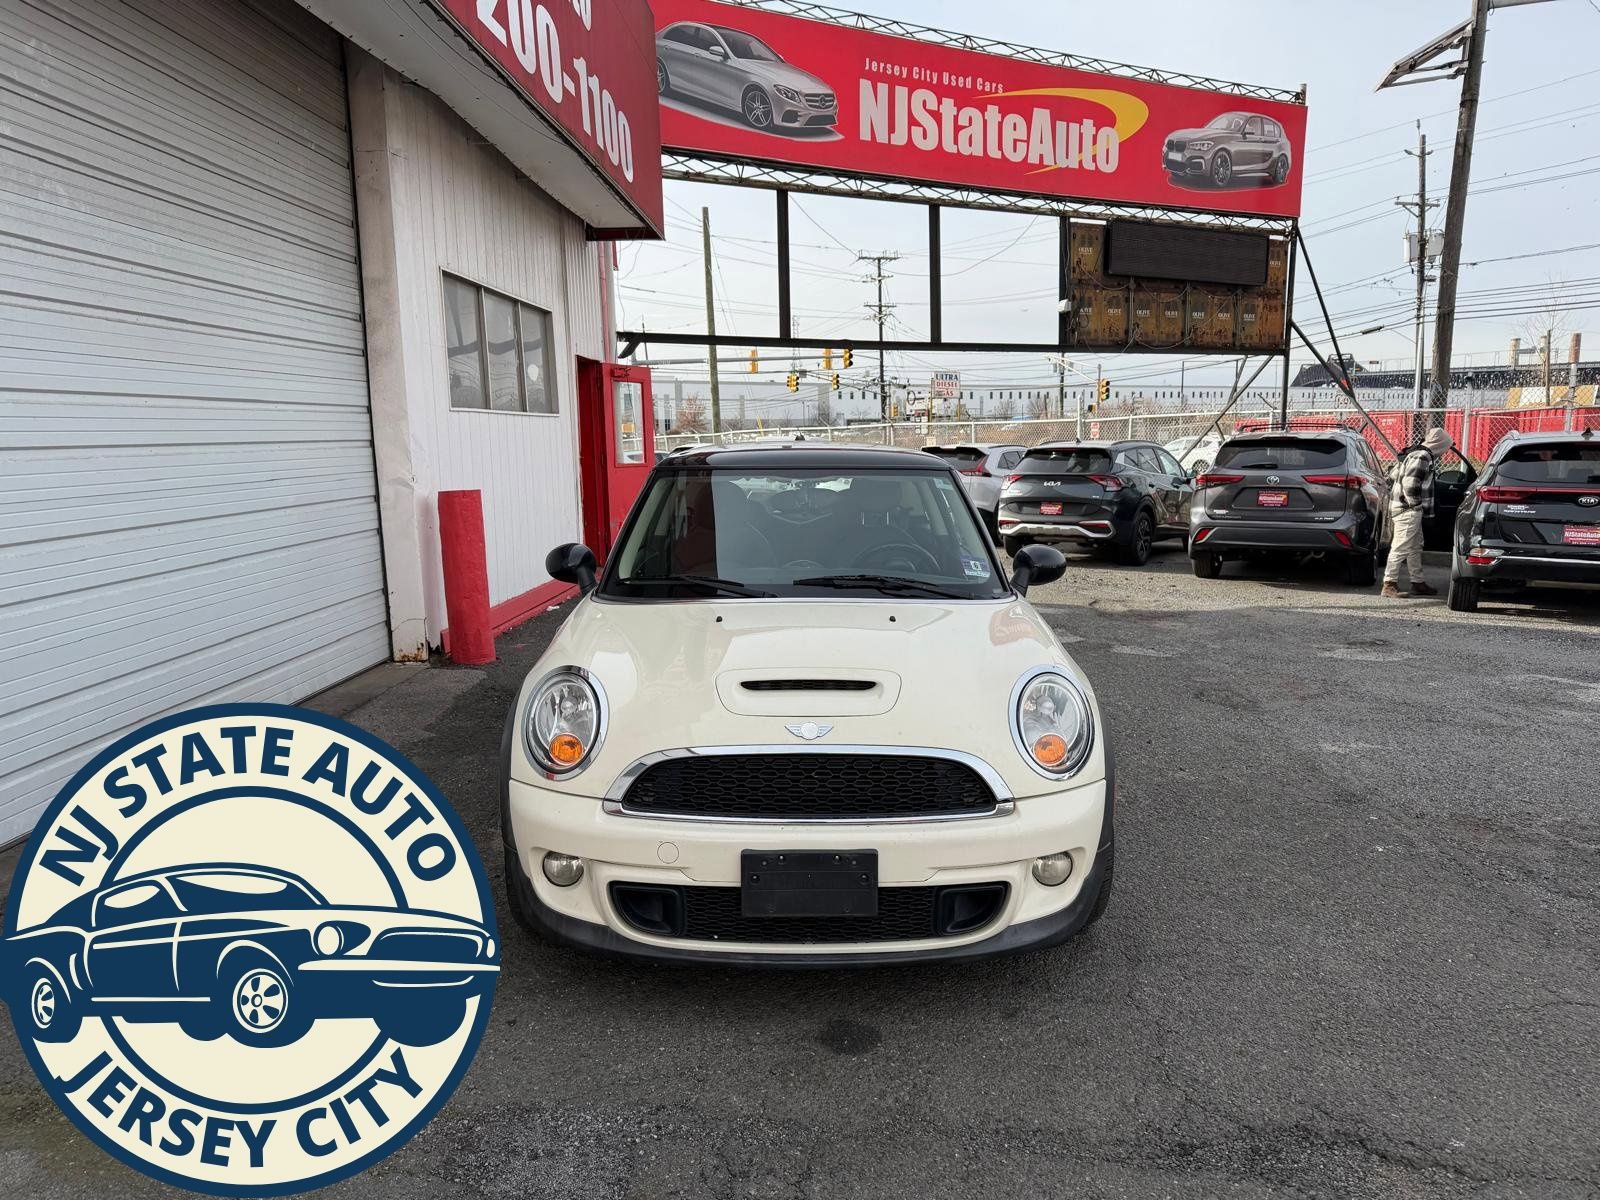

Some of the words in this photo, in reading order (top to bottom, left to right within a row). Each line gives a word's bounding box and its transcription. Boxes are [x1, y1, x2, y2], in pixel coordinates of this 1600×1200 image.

[864, 57, 908, 78] Jersey
[912, 66, 938, 84] City
[942, 71, 972, 89] Used
[976, 78, 1004, 94] Cars
[859, 78, 1120, 173] NJStateAuto
[935, 373, 958, 381] ULTRA
